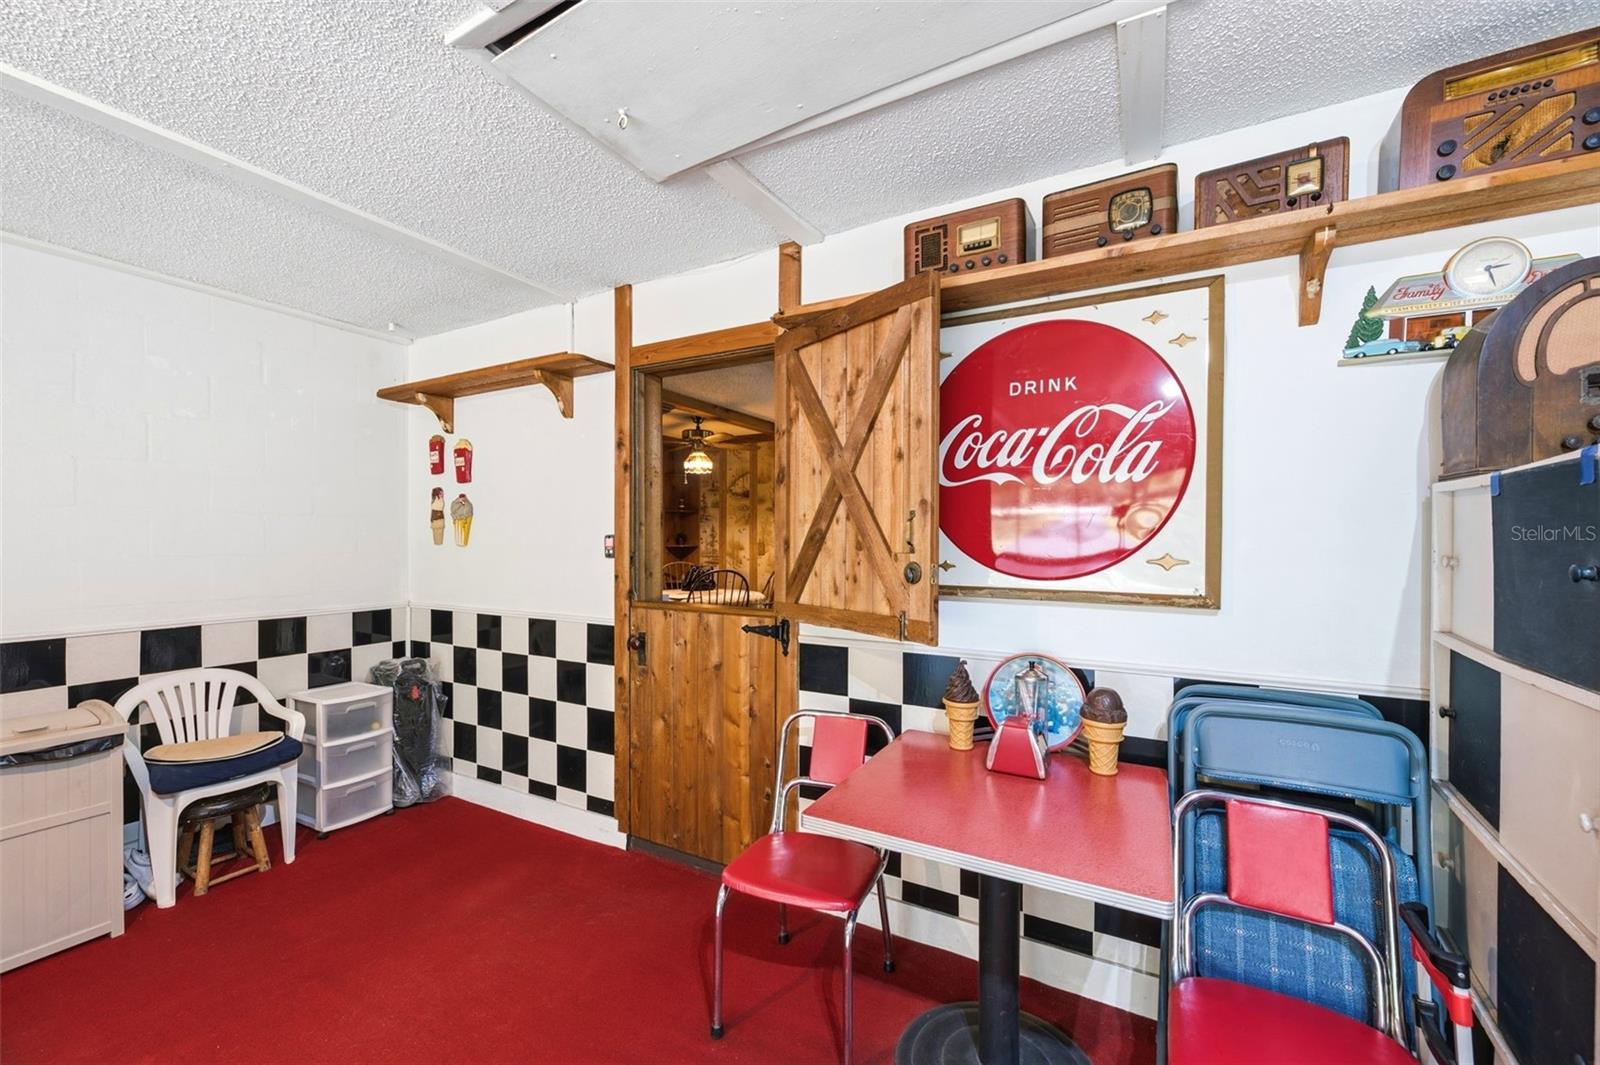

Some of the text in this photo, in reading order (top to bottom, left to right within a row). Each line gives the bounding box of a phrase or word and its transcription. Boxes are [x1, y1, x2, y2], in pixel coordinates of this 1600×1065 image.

[1393, 283, 1446, 300] Family
[1009, 376, 1078, 397] DRINK
[939, 400, 1177, 487] Coca-Cola
